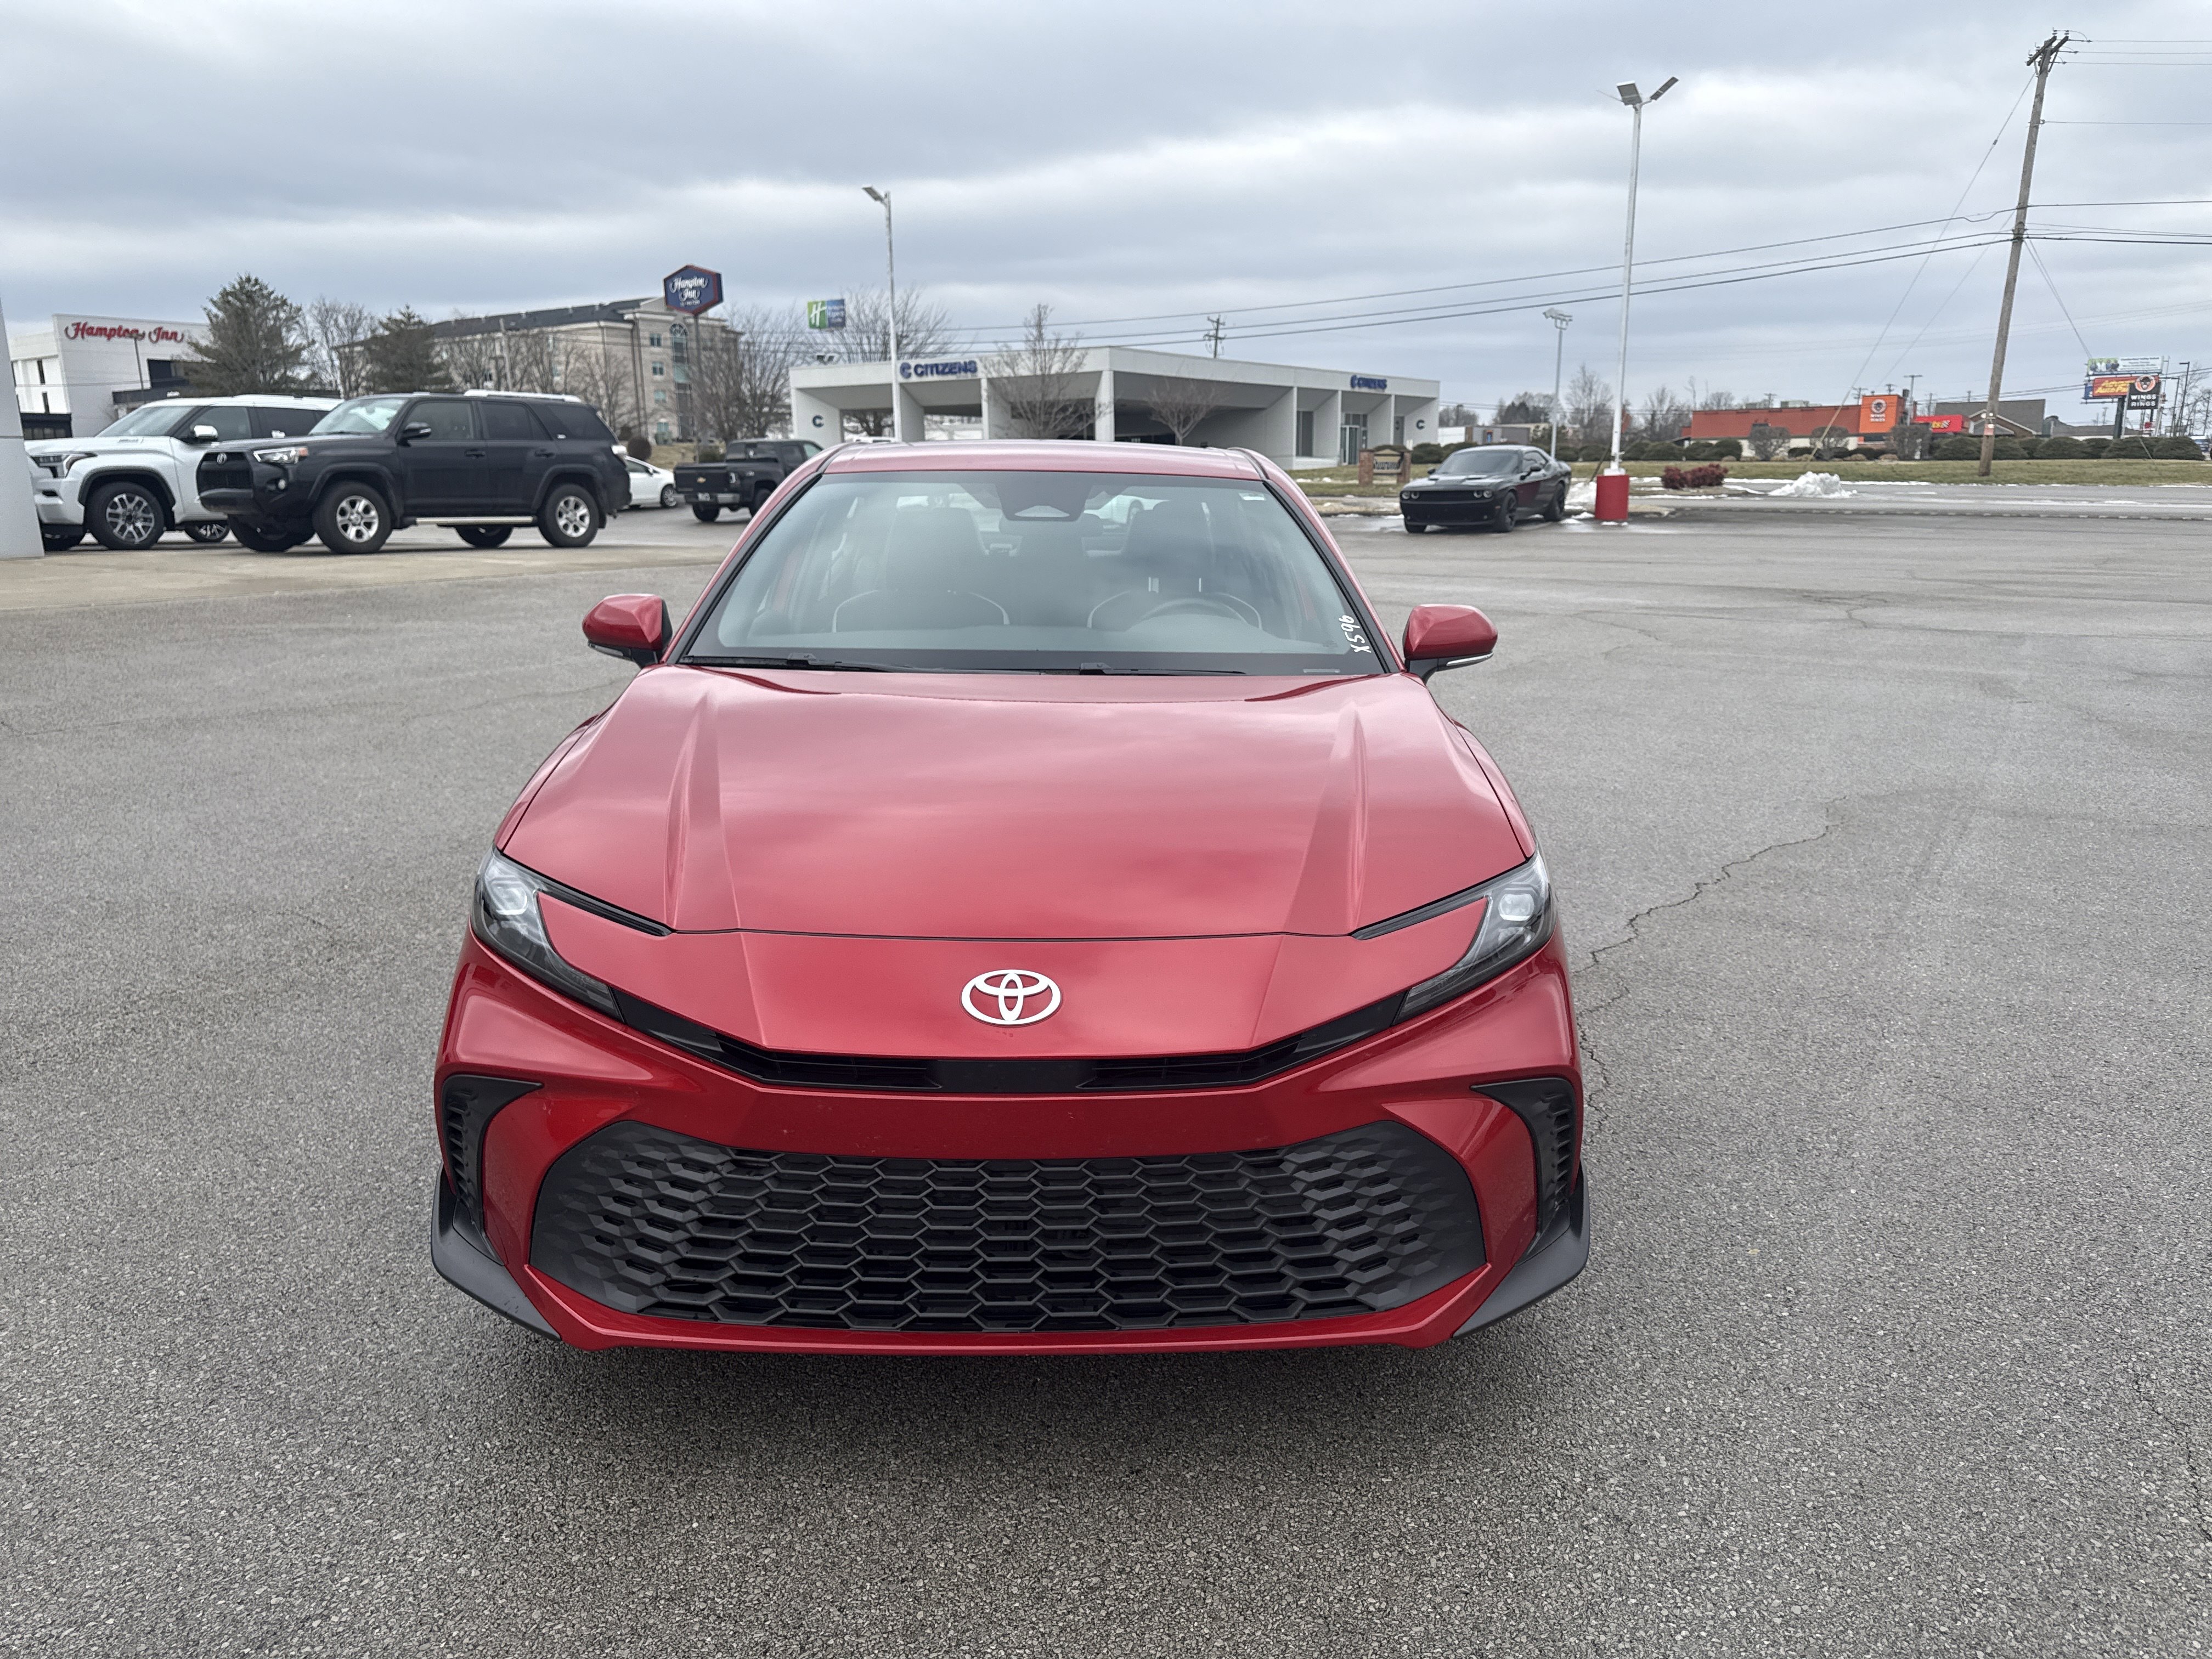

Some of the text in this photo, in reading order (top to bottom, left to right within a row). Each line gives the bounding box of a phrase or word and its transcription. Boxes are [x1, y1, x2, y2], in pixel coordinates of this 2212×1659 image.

[669, 276, 708, 294] Hampton
[679, 288, 701, 302] Inn
[64, 321, 185, 344] Hampton Inn
[913, 360, 978, 377] CITIZENS
[1339, 615, 1372, 653] X596
